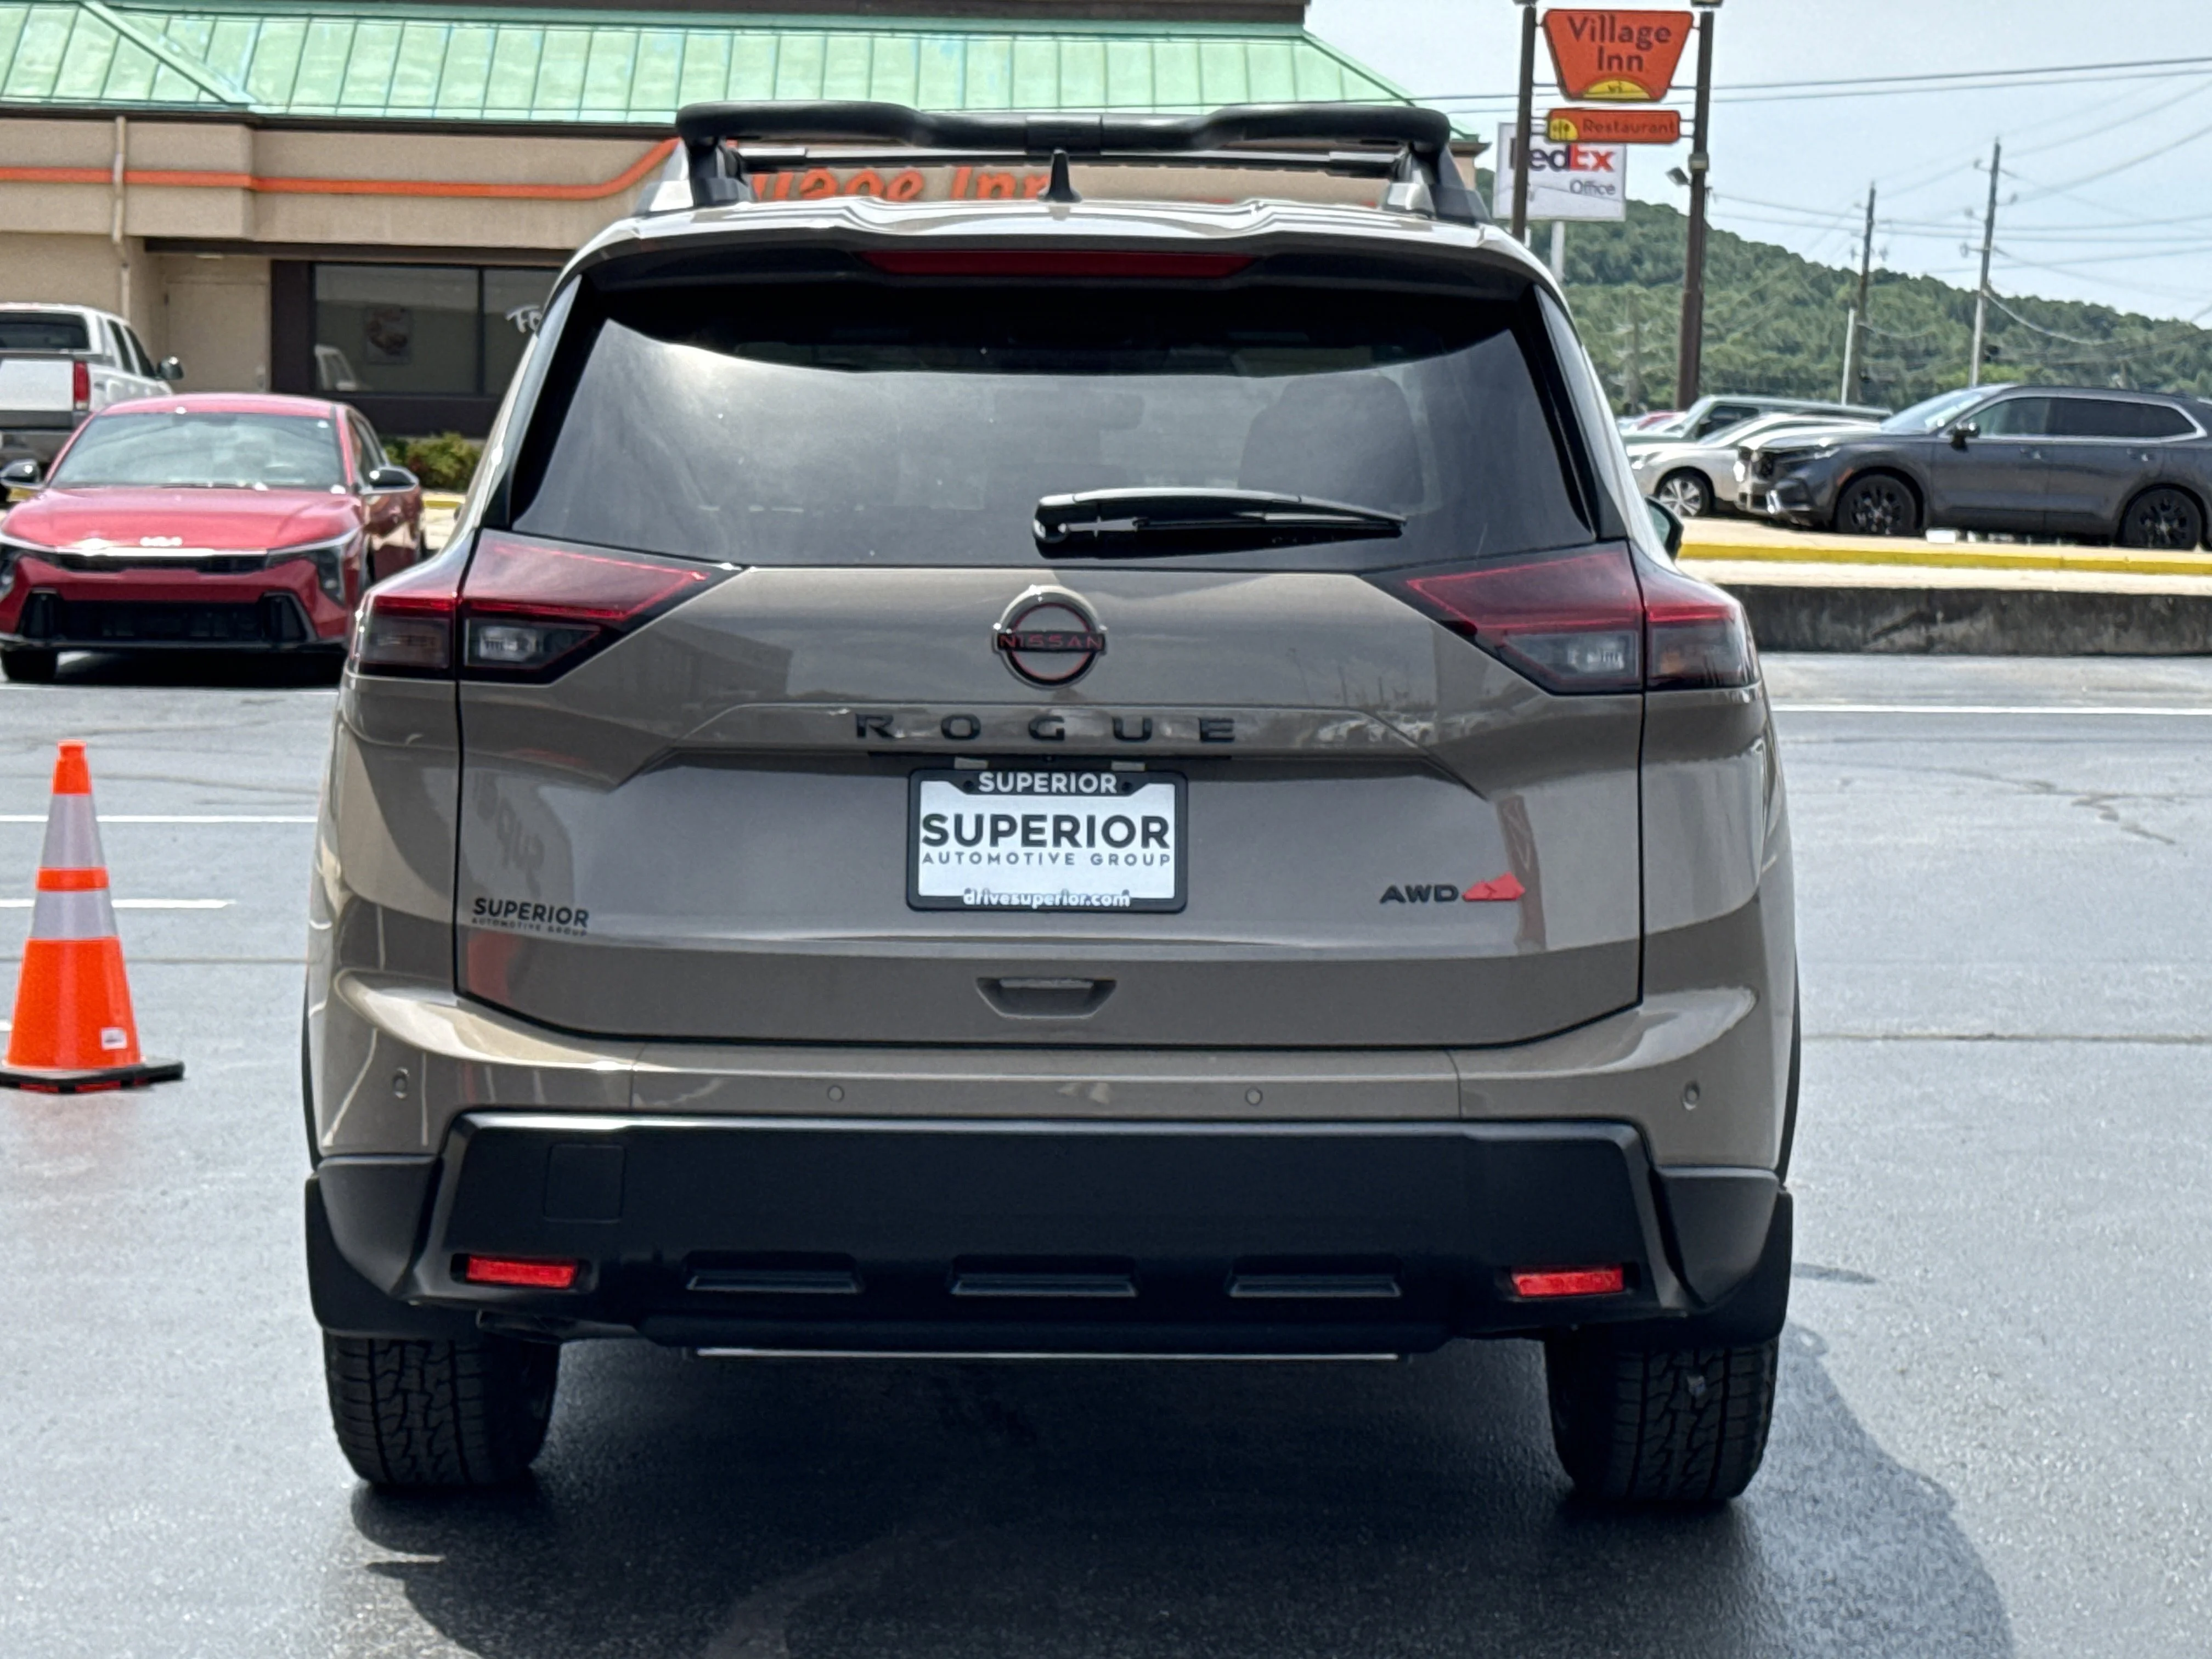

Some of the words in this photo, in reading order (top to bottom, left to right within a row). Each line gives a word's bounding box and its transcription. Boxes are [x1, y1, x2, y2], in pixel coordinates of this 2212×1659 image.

[1567, 14, 1672, 51] Village
[1598, 46, 1644, 72] Inn
[1583, 118, 1677, 134] Restaurant
[1510, 138, 1615, 172] edEx
[1570, 179, 1615, 196] Office
[1000, 633, 1103, 650] NISSAN
[855, 713, 1235, 742] ROGUE
[979, 772, 1118, 793] SUPERIOR
[922, 813, 1170, 849] SUPERIOR
[922, 851, 1075, 866] AUTOMOTIVE
[1090, 853, 1171, 867] GROUP
[963, 888, 1131, 910] drivesuperior.com
[1379, 884, 1459, 904] AWD
[473, 897, 590, 928] SUPERIOR
